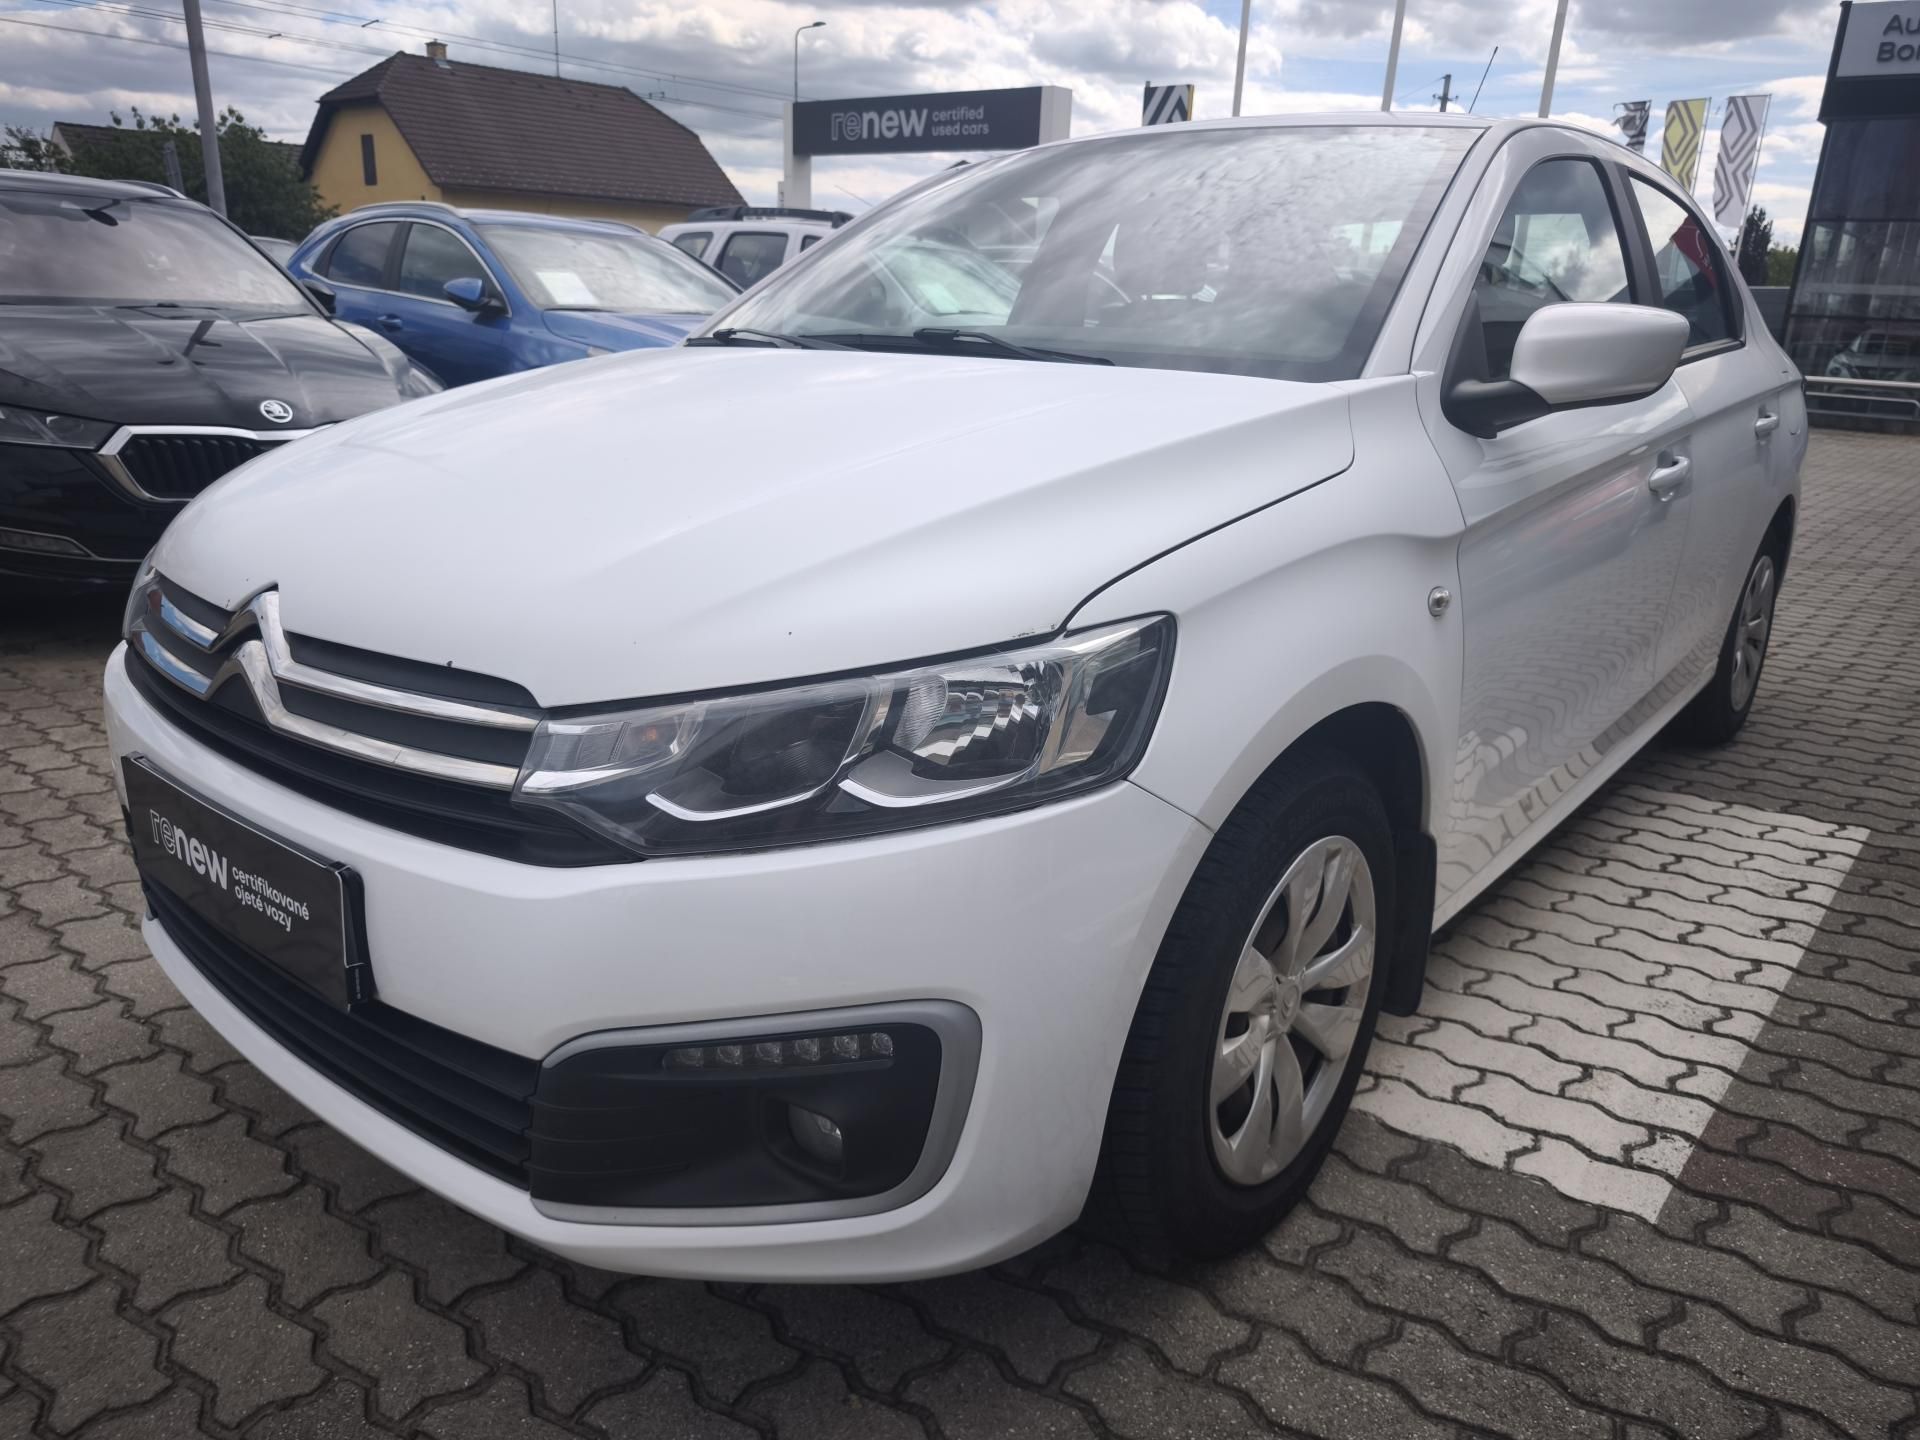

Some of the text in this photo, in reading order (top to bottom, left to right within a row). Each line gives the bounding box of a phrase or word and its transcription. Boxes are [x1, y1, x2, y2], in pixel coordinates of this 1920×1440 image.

[1882, 13, 1920, 36] Au
[831, 108, 928, 141] renew
[931, 122, 989, 136] used cars
[932, 105, 984, 122] certified
[150, 808, 228, 890] renew
[232, 866, 310, 921] certifikované
[234, 885, 292, 932] ojeté vozy
